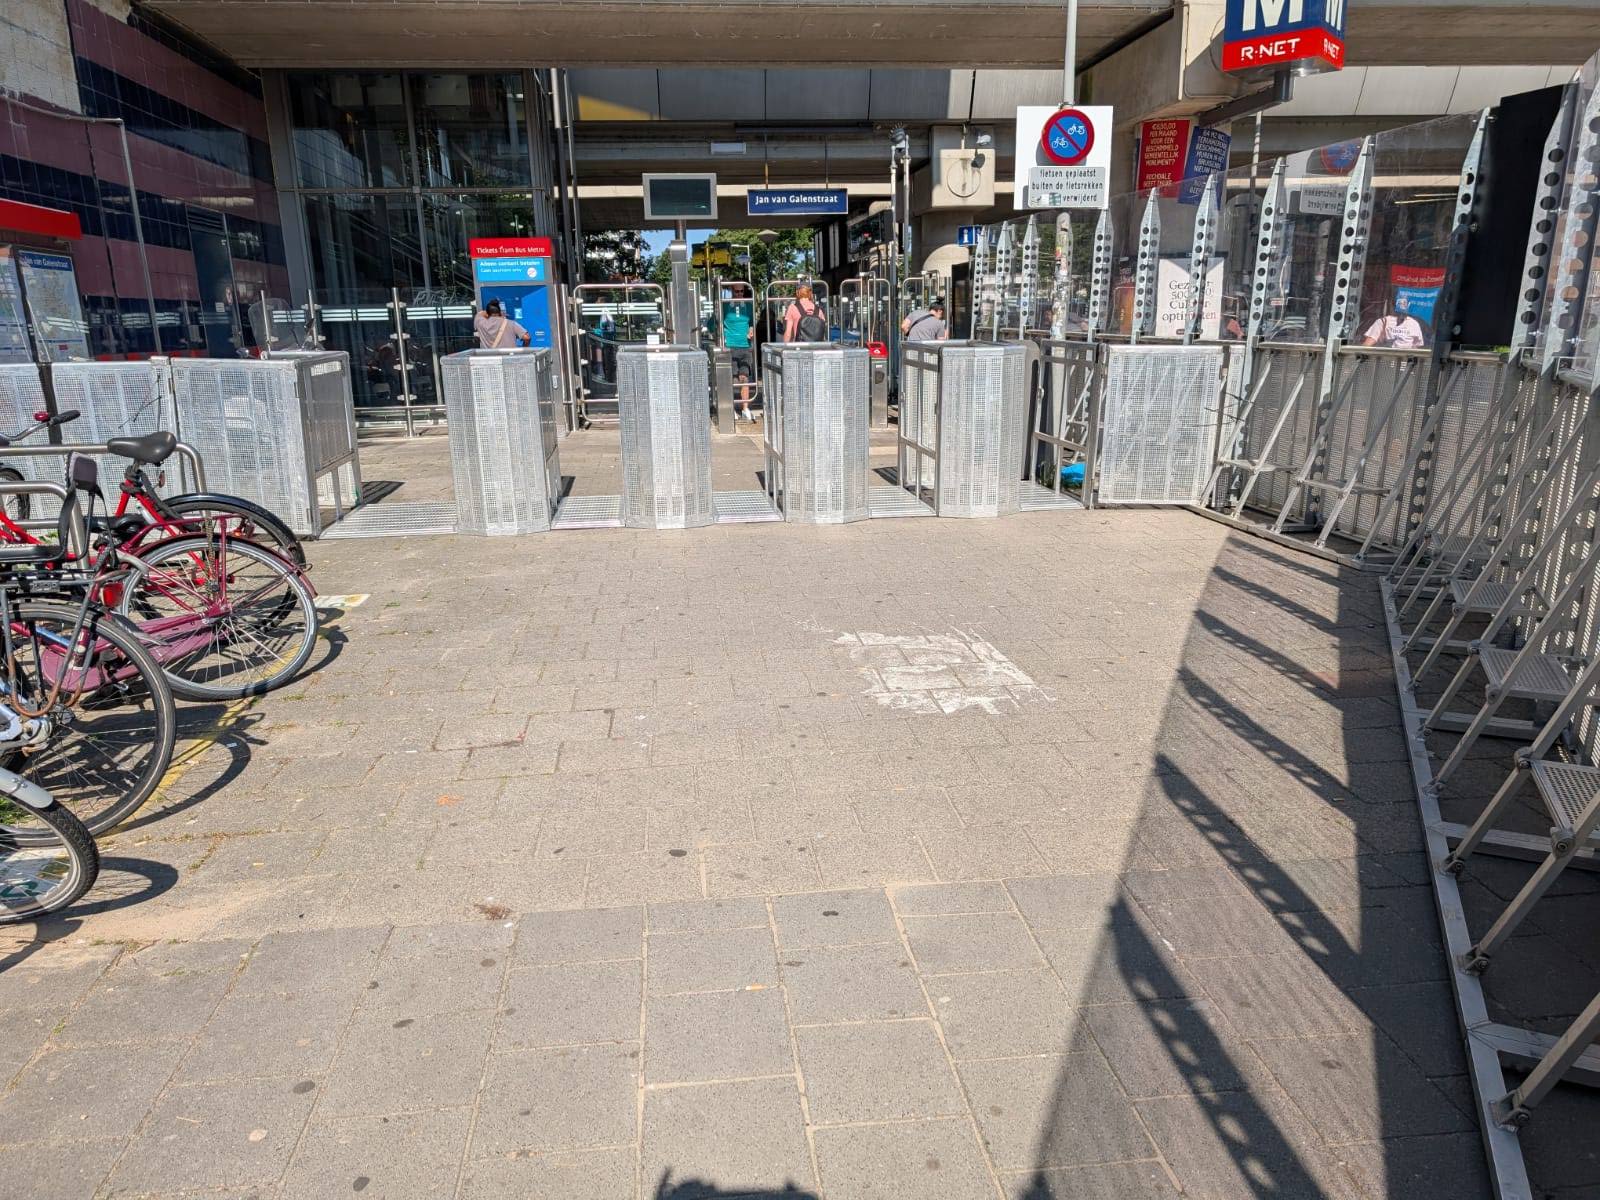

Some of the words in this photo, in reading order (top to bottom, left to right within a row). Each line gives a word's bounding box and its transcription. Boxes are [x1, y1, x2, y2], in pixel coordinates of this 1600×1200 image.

[1040, 169, 1062, 178] fietsen
[1066, 169, 1096, 179] geplaatst
[1032, 181, 1053, 190] buiten
[1056, 181, 1063, 190] de
[1066, 181, 1103, 190] fietsrekken
[755, 195, 769, 205] Jan
[771, 196, 787, 204] van
[789, 194, 838, 204] Galenstraat
[1063, 194, 1097, 204] verwijderd
[499, 246, 515, 254] Tram
